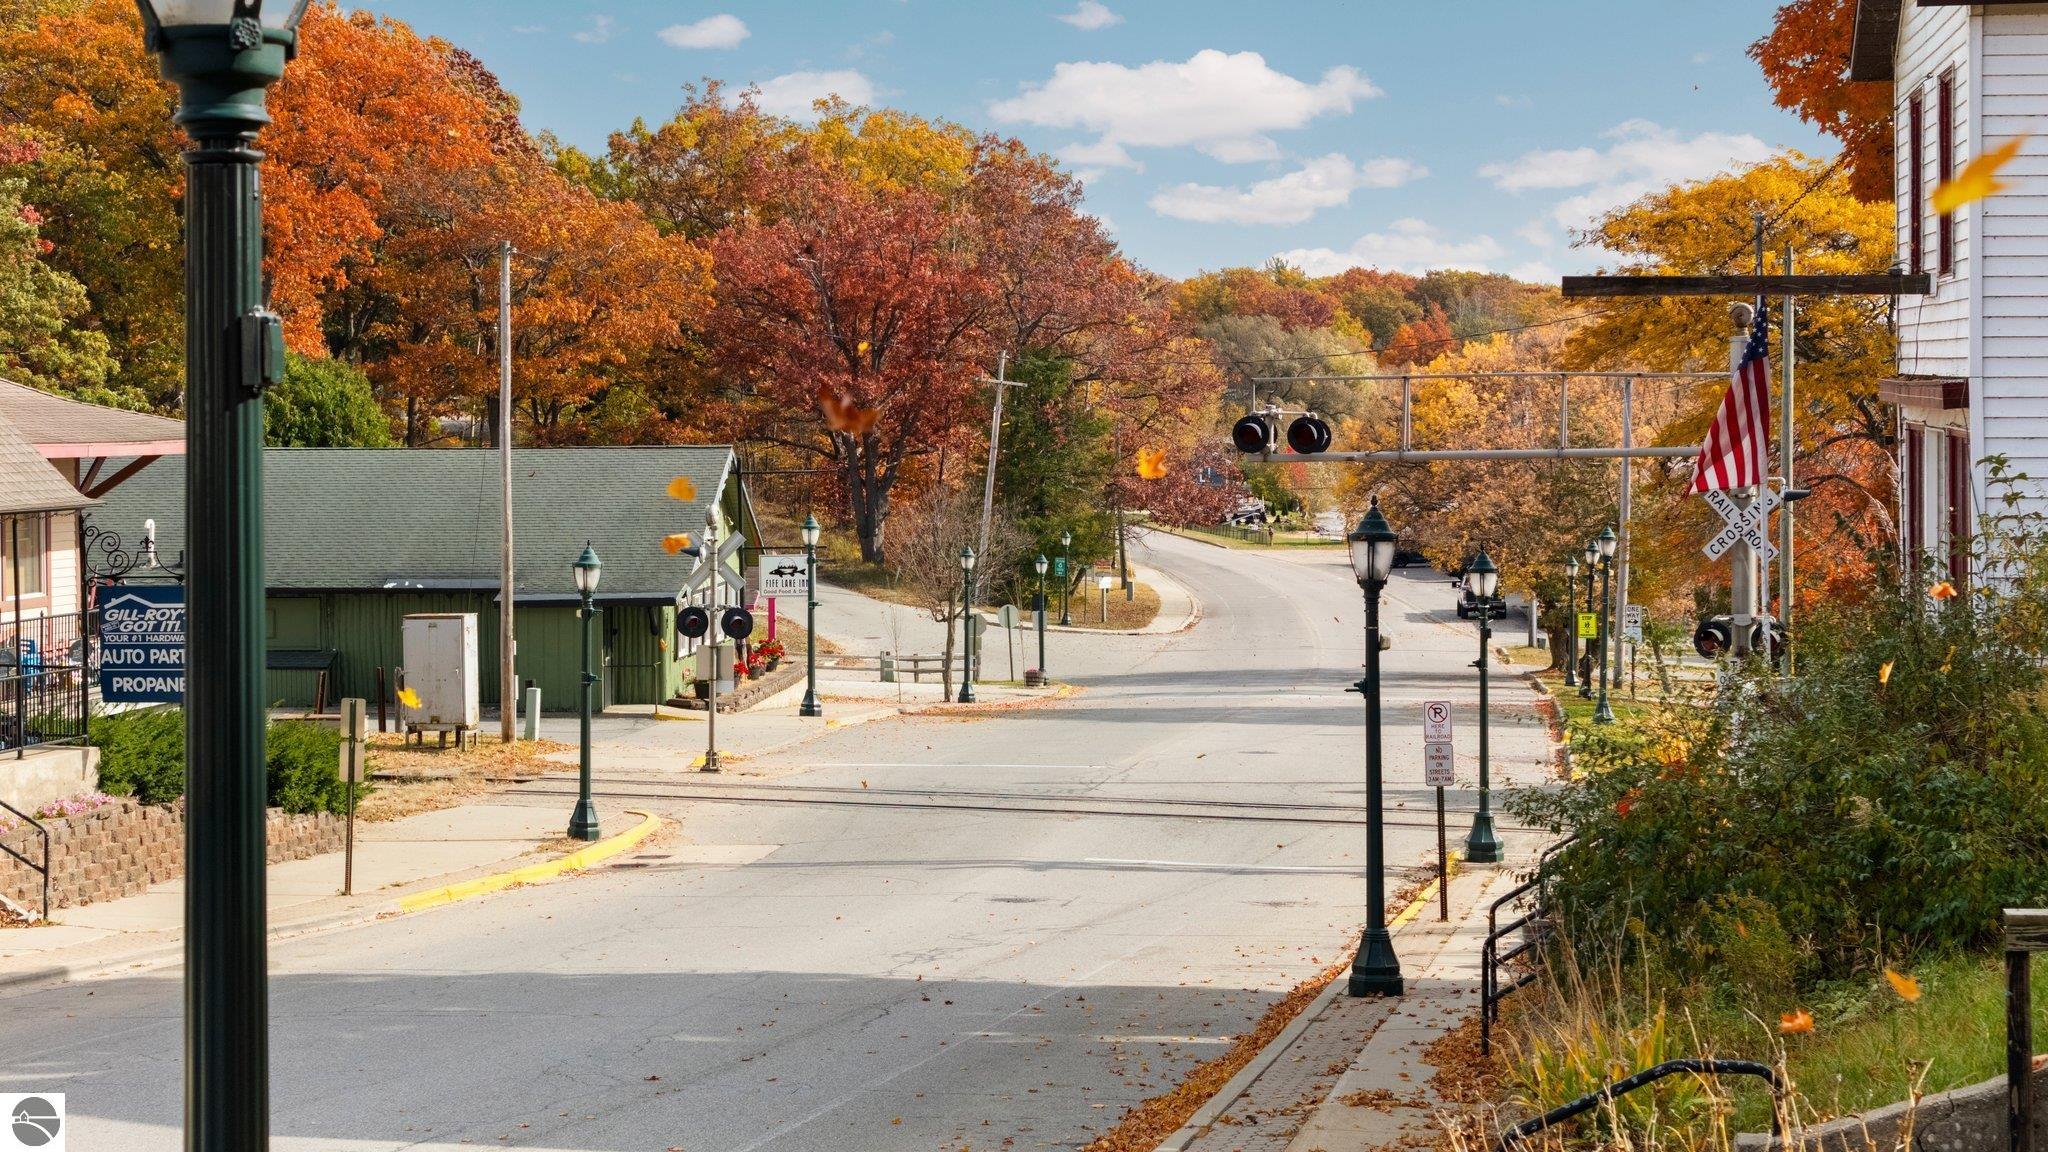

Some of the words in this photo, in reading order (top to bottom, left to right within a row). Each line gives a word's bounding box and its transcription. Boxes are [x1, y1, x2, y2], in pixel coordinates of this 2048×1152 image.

[765, 579, 779, 588] FIFE
[781, 579, 796, 588] LAKE
[104, 608, 186, 621] GILL-ROY'
[119, 620, 157, 632] GOT
[160, 620, 181, 632] IT!
[104, 634, 129, 642] YOUR
[131, 634, 142, 642] #1
[145, 634, 186, 642] HARDWA
[101, 648, 145, 664] AUTO
[149, 648, 186, 664] PART
[112, 676, 186, 693] PROPANE
